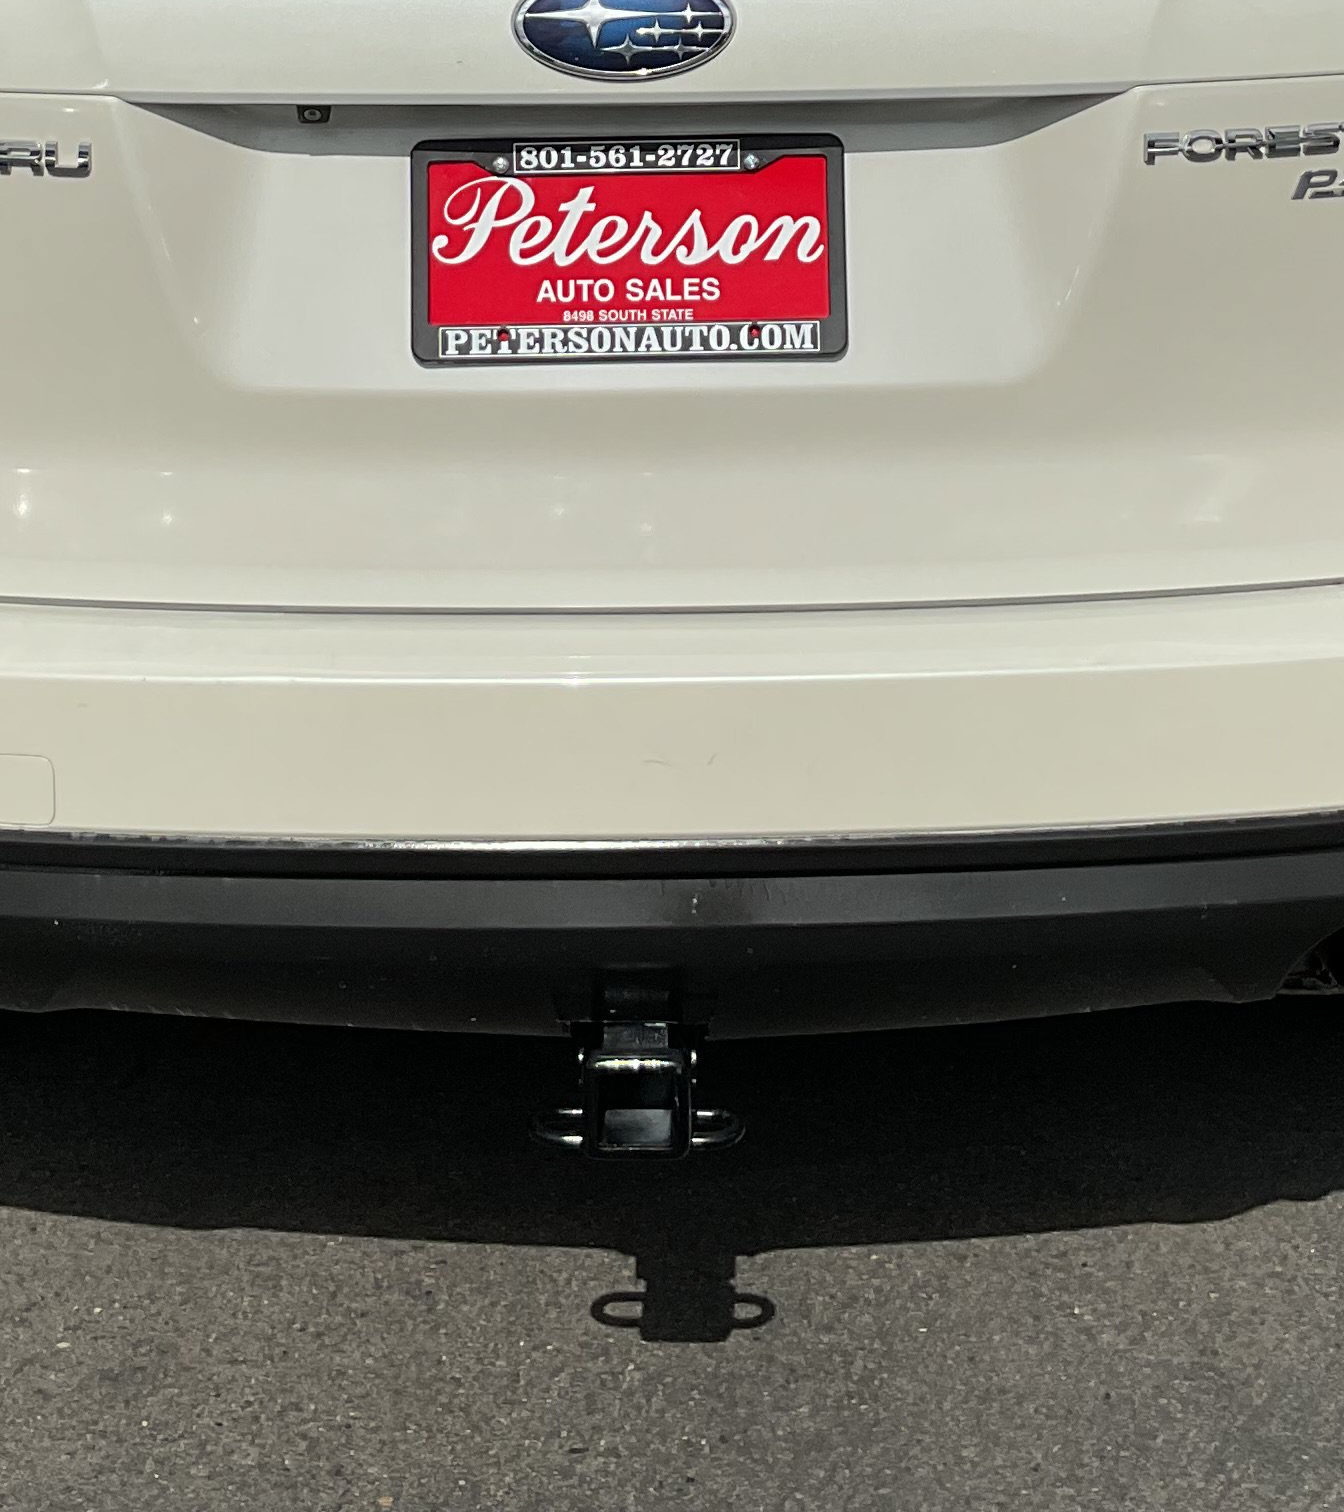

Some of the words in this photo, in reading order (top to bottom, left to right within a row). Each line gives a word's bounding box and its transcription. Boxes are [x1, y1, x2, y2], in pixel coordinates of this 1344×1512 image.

[518, 143, 735, 170] 801-561-2727
[431, 175, 826, 267] Peterson
[536, 280, 616, 303] AUTO
[625, 277, 721, 302] SALES
[562, 309, 595, 322] 8498
[598, 309, 647, 322] SOUTH
[651, 308, 694, 321] STATE
[444, 324, 814, 356] PETERSONAUTO.COM
